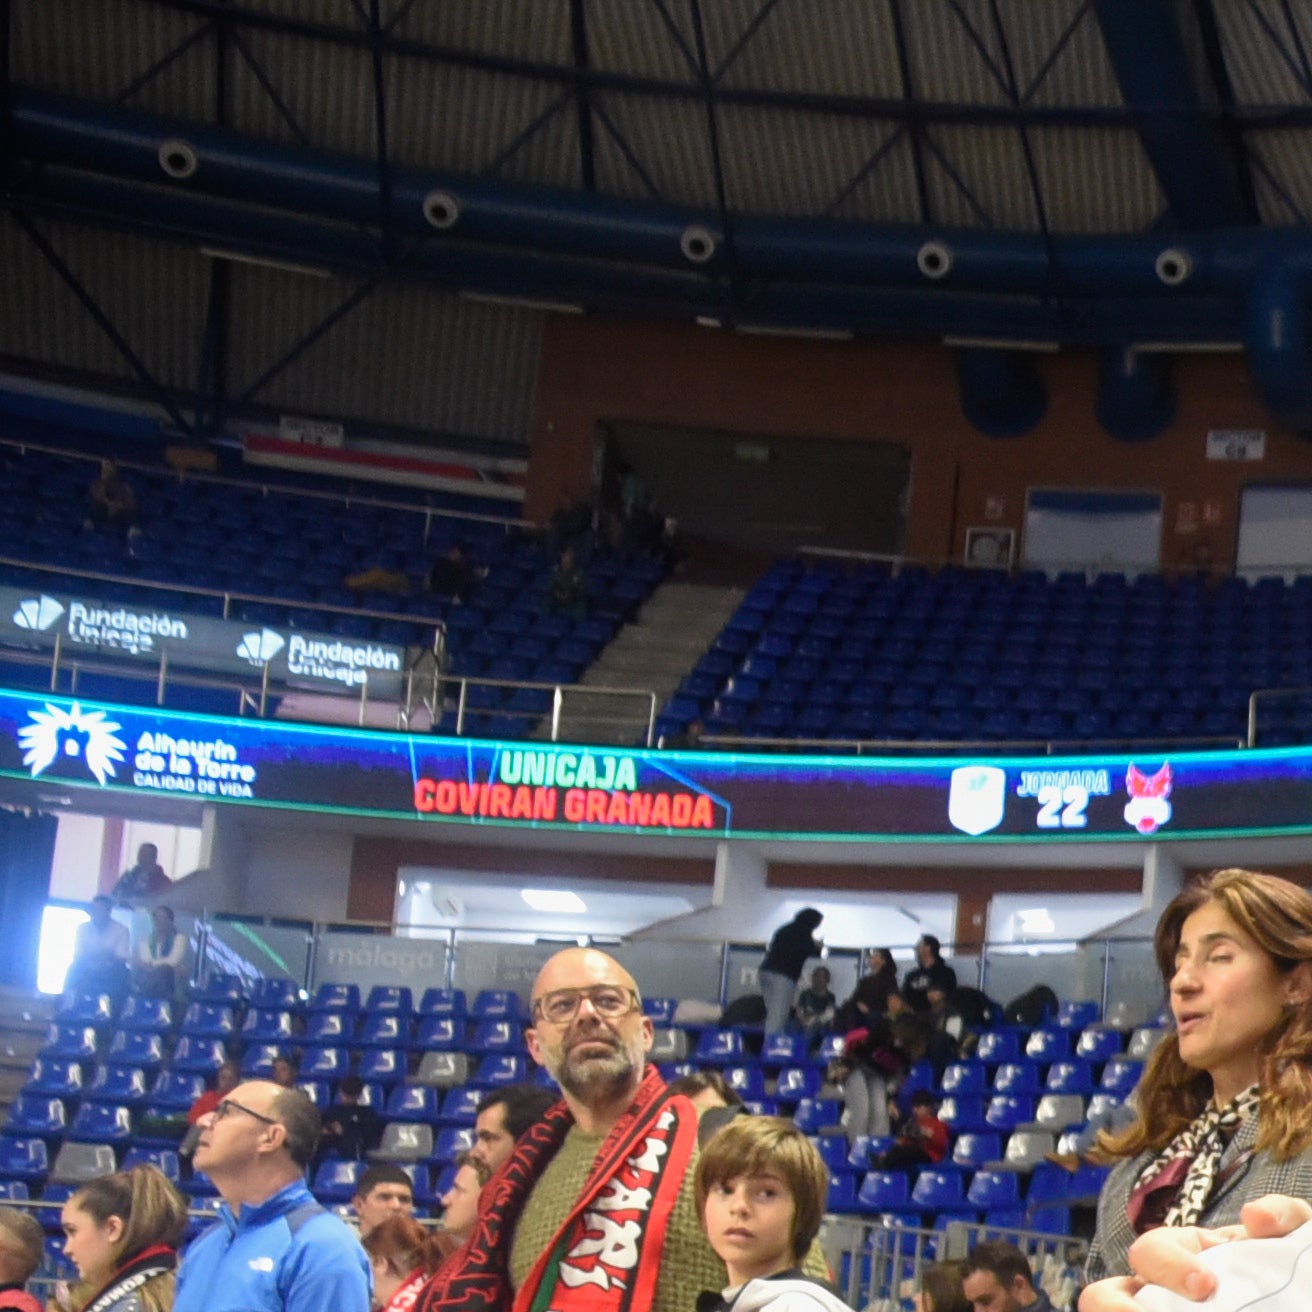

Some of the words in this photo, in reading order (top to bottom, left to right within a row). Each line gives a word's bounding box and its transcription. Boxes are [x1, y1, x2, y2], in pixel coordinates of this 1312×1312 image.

[69, 602, 188, 639] Fundación
[288, 634, 400, 671] Fundación
[137, 731, 237, 762] Alhaurín
[133, 771, 195, 792] CALIDAD
[197, 778, 217, 795] DE
[218, 781, 254, 798] VIDA
[135, 751, 166, 773] de
[169, 753, 192, 776] la
[195, 756, 257, 783] Torre
[500, 750, 638, 790] UNICAJA
[413, 778, 556, 821] COVIRAN
[563, 785, 714, 829] GRANADA
[1036, 786, 1089, 829] 22
